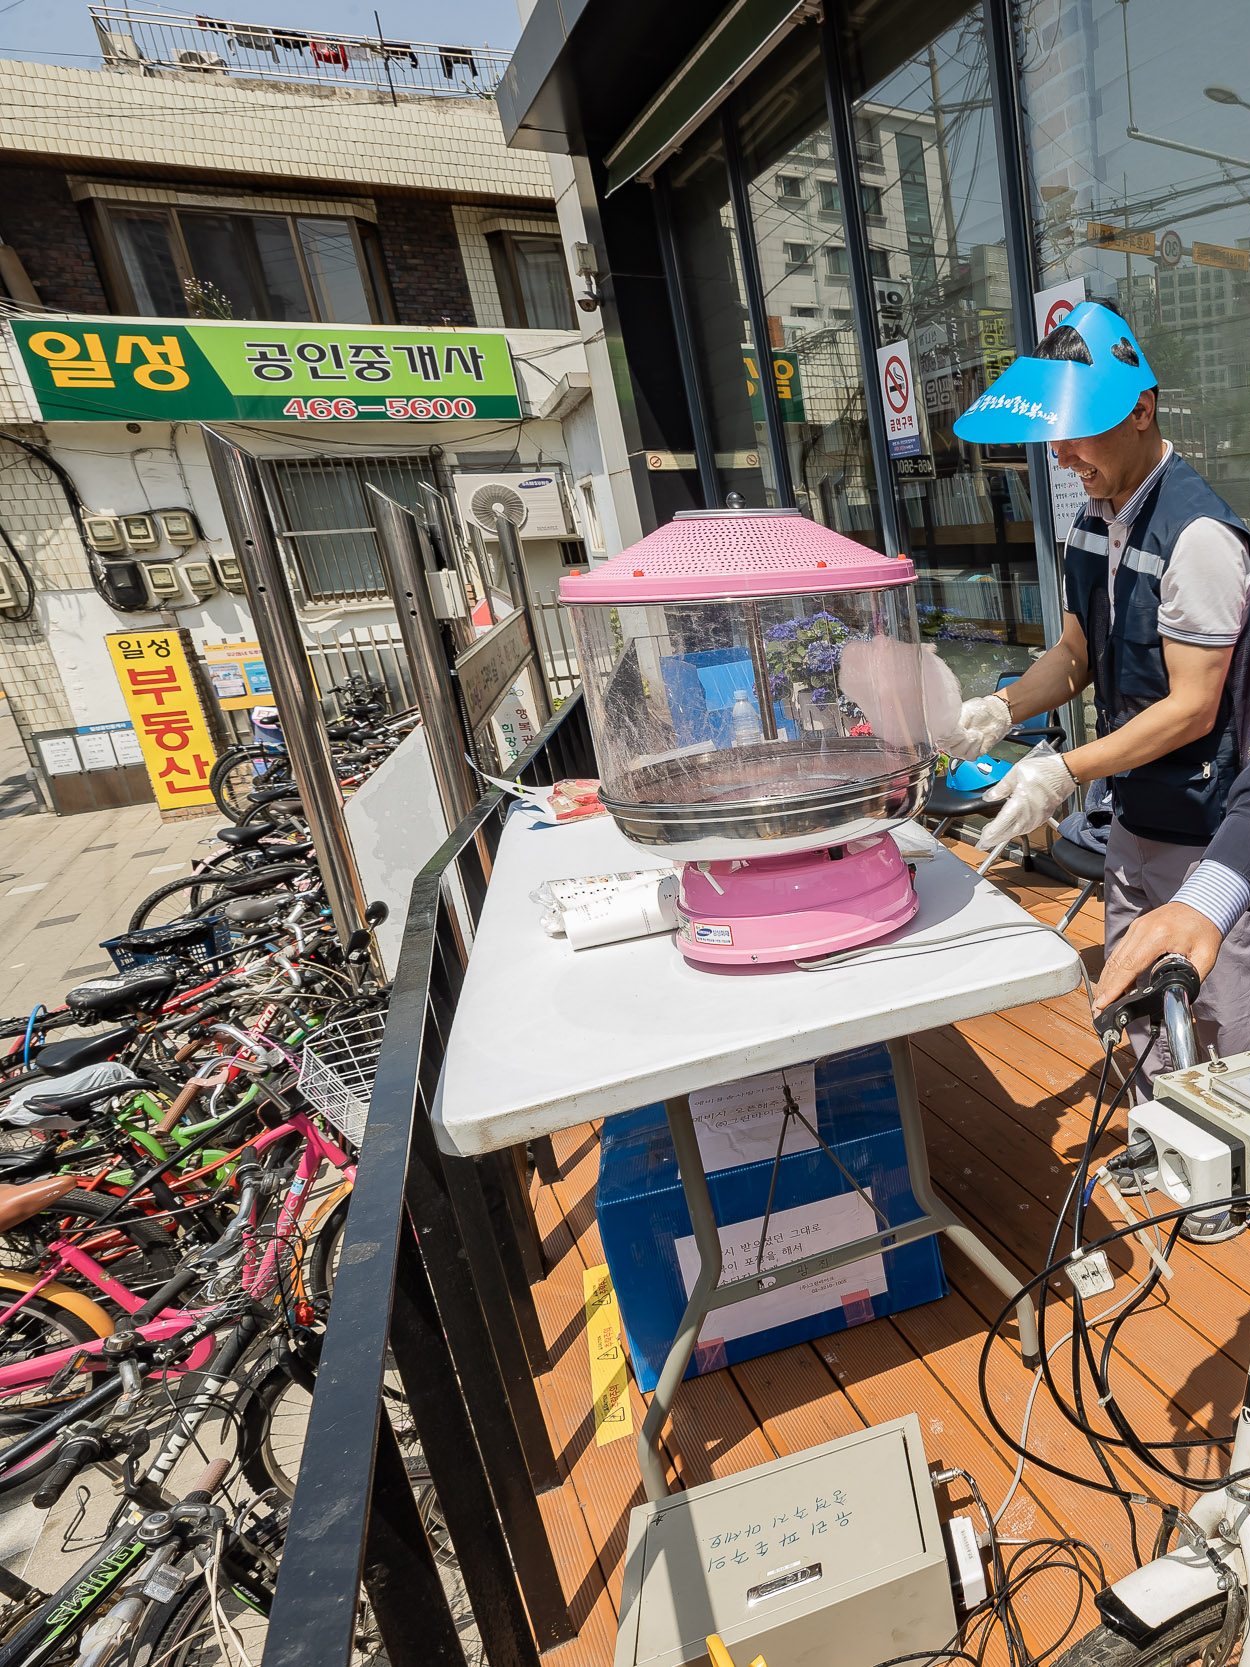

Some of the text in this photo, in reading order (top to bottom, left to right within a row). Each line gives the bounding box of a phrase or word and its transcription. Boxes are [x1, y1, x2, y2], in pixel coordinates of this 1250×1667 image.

[28, 331, 485, 392] 일성 공인중개사
[283, 398, 478, 420] 466-5600
[889, 415, 914, 432] 금연구역
[521, 479, 550, 487] SAMSUNG
[117, 638, 171, 659] 일성
[126, 665, 210, 794] 부동산
[790, 1223, 821, 1238] 그대로
[782, 1243, 803, 1255] 해서
[598, 1276, 609, 1295] 추락주의
[603, 1326, 613, 1348] 추락주의
[609, 1383, 621, 1408] 추락주의
